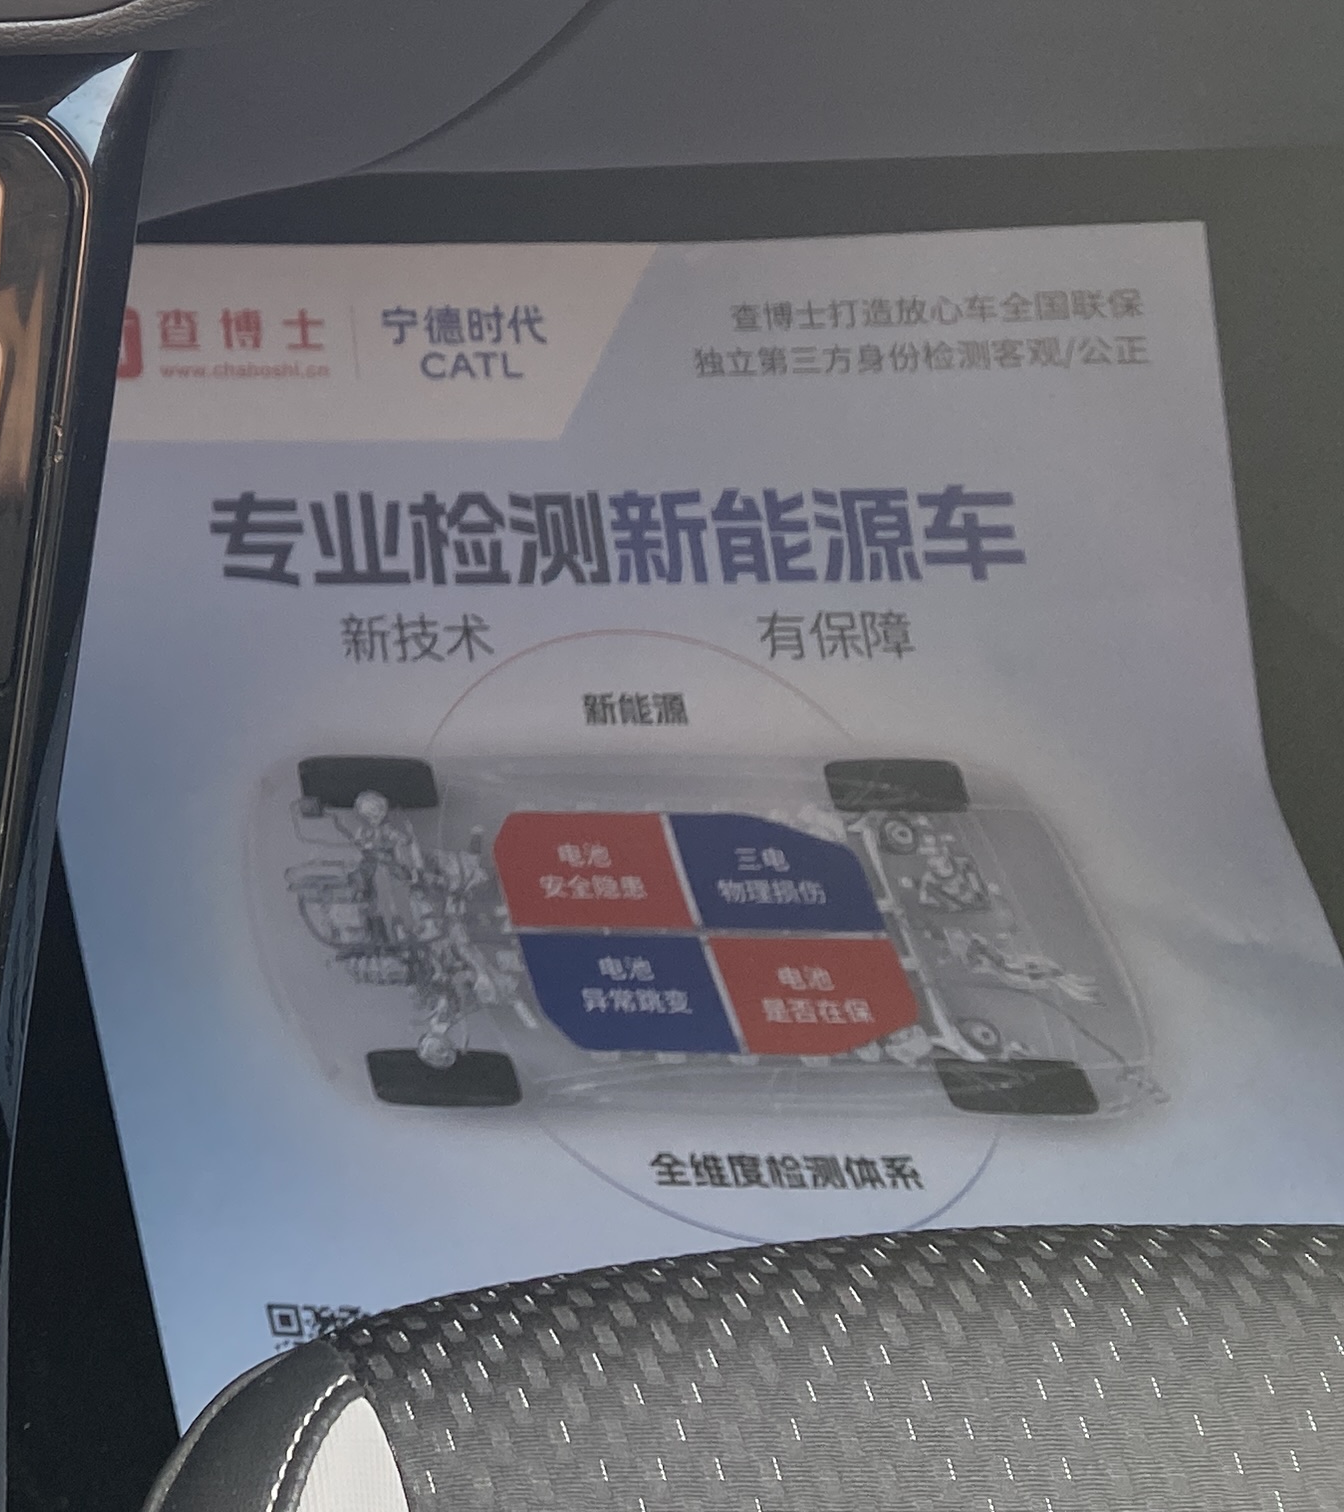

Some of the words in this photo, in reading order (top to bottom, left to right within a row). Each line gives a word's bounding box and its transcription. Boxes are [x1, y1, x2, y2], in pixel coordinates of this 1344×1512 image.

[156, 307, 325, 352] 查博士
[381, 304, 549, 346] 宁德时代
[729, 287, 1144, 333] 查博士打造放心车全国联保
[419, 351, 525, 381] CATL
[208, 485, 1029, 589] 专业检测新能源车
[339, 611, 496, 664] 新技术
[757, 610, 918, 663] 有保障
[581, 690, 689, 727] 新能源
[556, 841, 613, 869] 电池
[734, 846, 792, 873] 三电
[597, 955, 656, 982] 电池
[776, 965, 835, 992] 电池
[650, 1151, 926, 1190] 全维度检测体系
